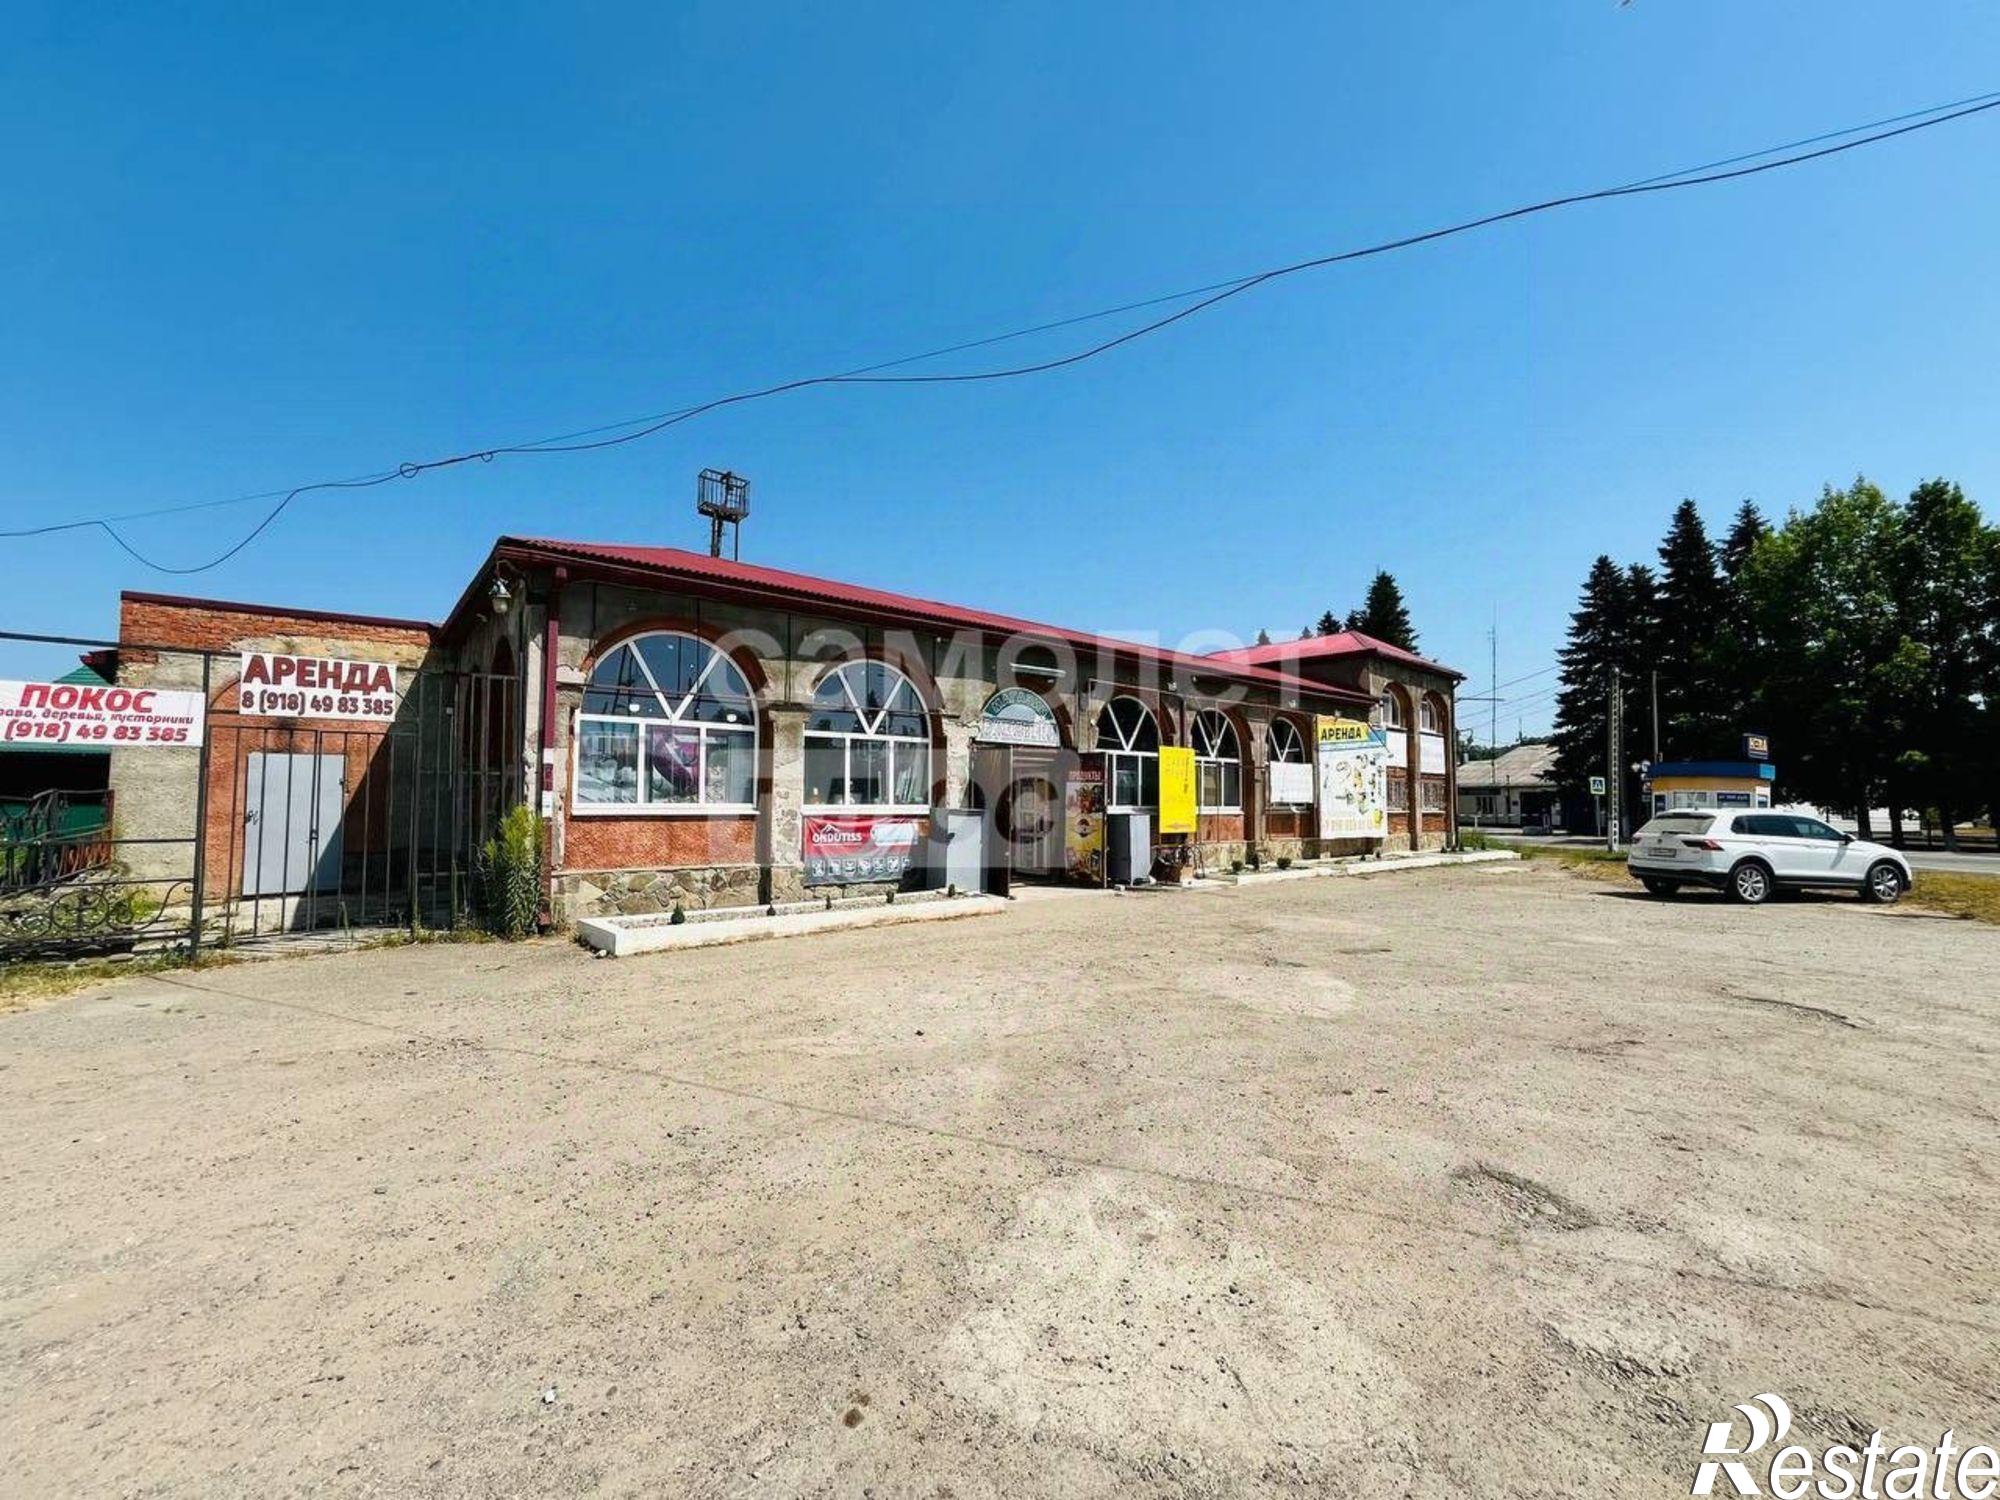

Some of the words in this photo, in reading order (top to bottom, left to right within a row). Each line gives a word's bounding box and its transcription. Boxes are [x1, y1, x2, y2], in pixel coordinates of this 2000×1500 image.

[243, 654, 394, 695] АРЕНДА
[19, 684, 157, 713] ПОКОС
[241, 690, 255, 708] 8
[259, 689, 306, 716] (918)
[310, 694, 333, 712] 49
[337, 696, 359, 714] 83
[362, 698, 394, 715] 385
[4, 719, 71, 743] (918)
[76, 724, 108, 740] 49
[113, 725, 141, 741] 83
[146, 726, 188, 742] 385
[1320, 726, 1362, 741] АРЕНДА
[812, 832, 862, 844] ONDUTISS
